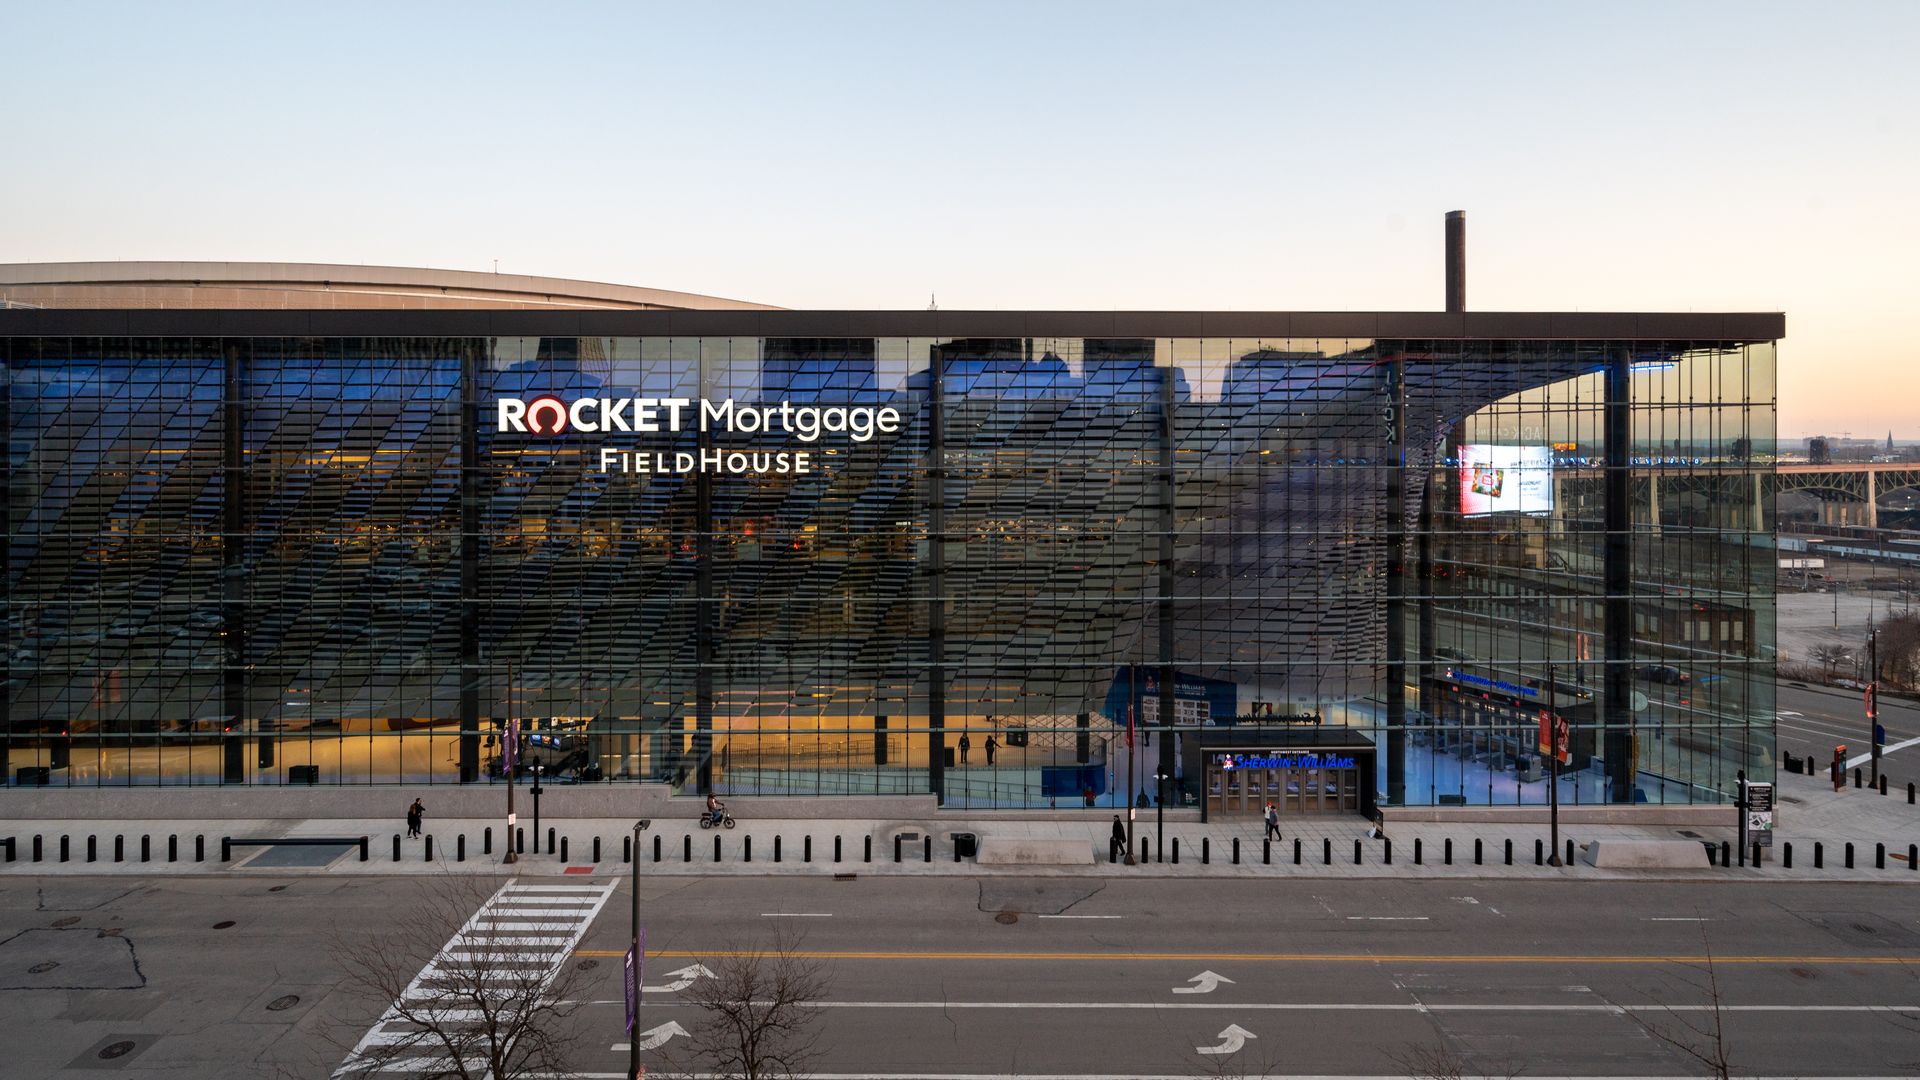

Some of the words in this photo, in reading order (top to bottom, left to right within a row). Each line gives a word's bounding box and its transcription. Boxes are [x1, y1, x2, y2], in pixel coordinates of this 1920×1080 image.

[498, 395, 690, 436] ROCKET
[700, 398, 900, 442] Mortgage
[1236, 755, 1354, 770] SHERWIN-WILLIAMS
